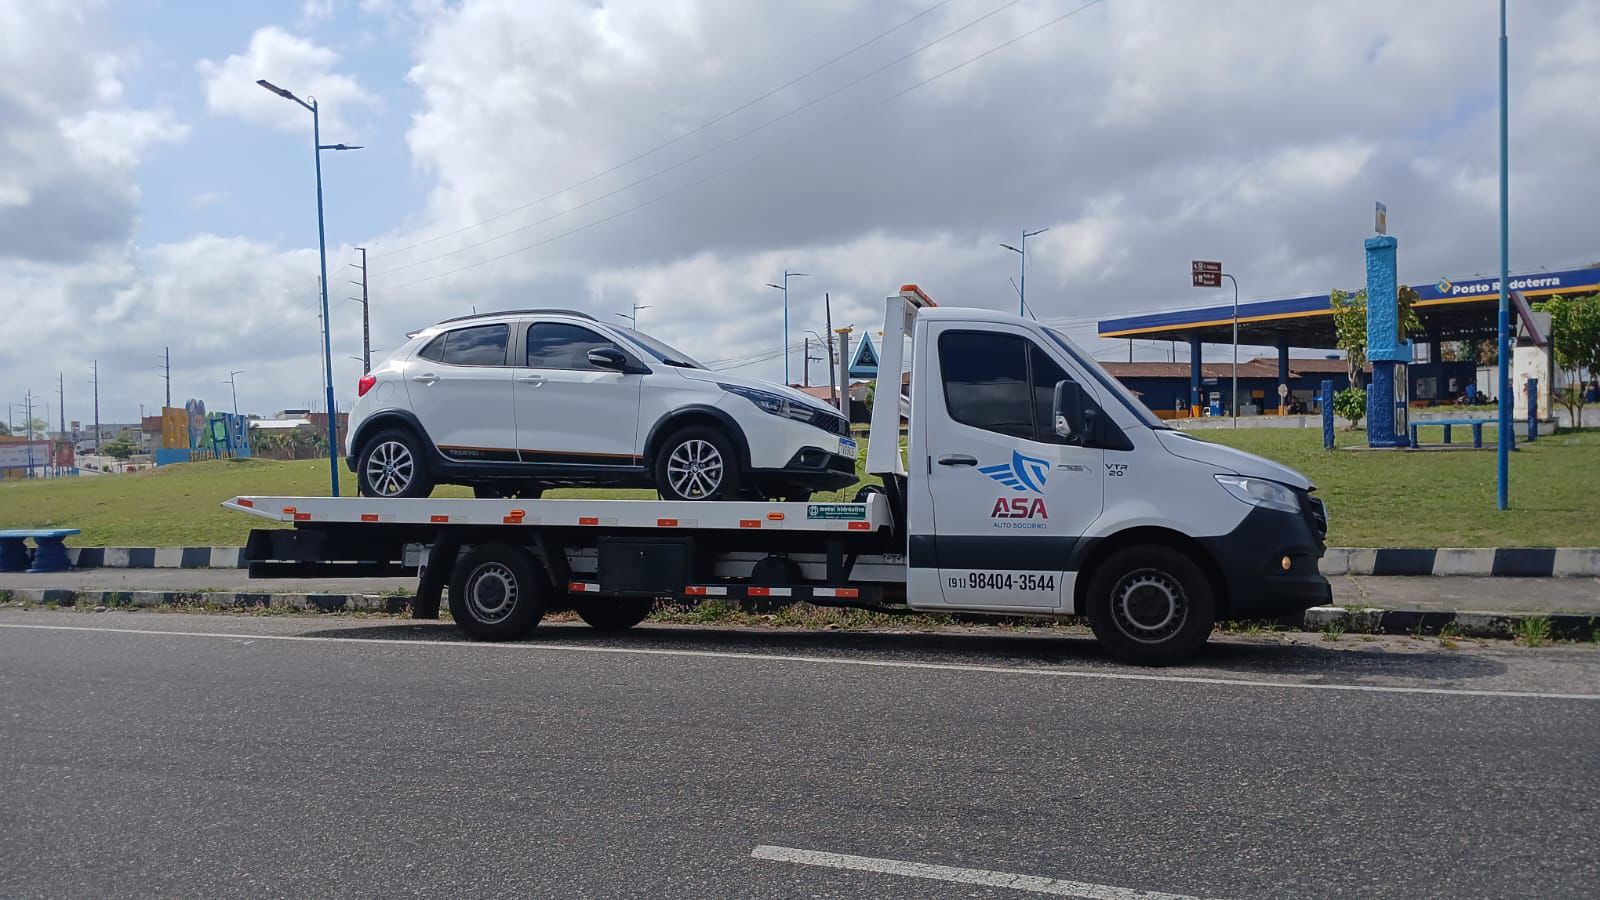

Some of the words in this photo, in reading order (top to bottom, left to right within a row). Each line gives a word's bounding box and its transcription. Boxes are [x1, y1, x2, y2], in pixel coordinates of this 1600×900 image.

[1452, 282, 1489, 295] Posto
[1492, 277, 1560, 291] Rdoterra
[1105, 463, 1128, 471] VTR
[991, 497, 1048, 519] ASA
[948, 577, 966, 589] (91)
[969, 572, 1055, 591] 98404-3544
